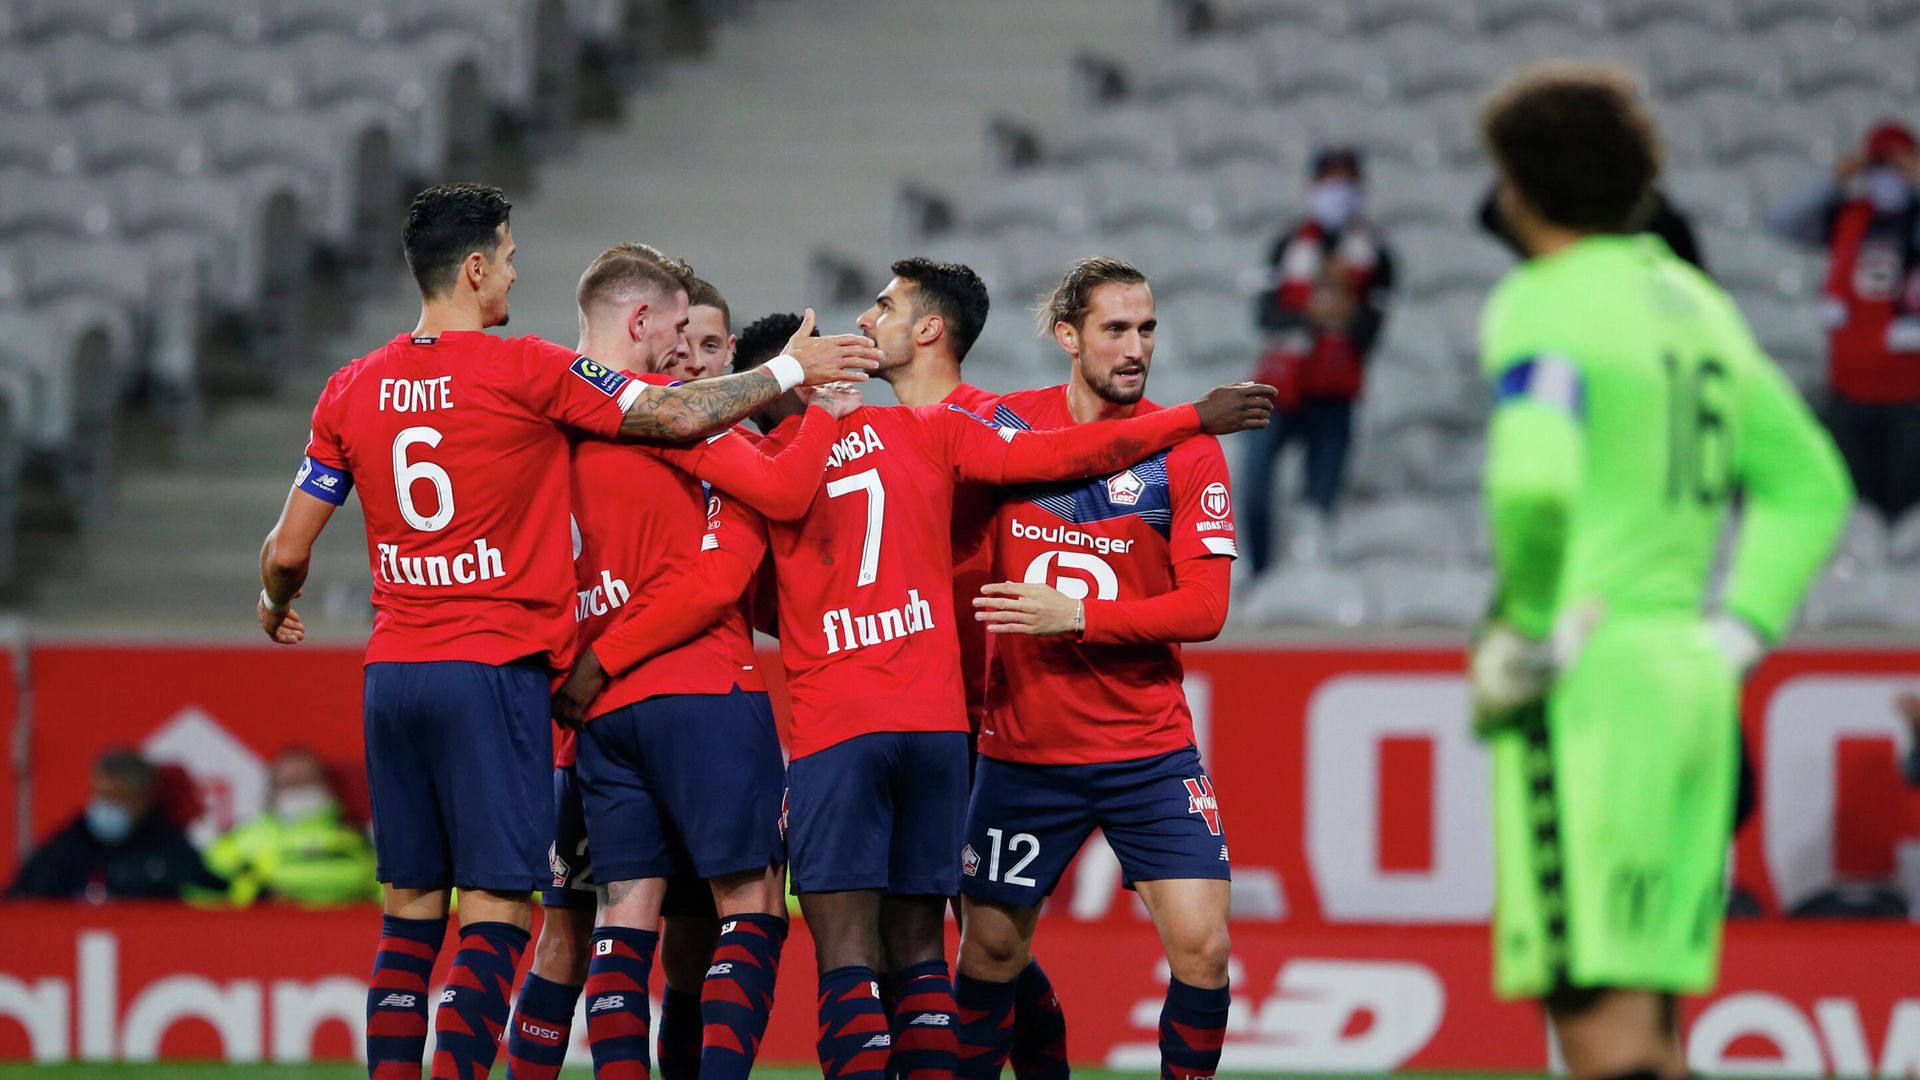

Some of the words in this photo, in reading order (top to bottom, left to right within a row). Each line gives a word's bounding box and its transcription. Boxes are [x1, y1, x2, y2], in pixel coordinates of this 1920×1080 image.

[379, 375, 454, 412] FONTE
[824, 424, 885, 471] AMBA
[392, 426, 455, 532] 6
[826, 467, 885, 587] 7
[1011, 518, 1134, 555] boulanger
[377, 538, 506, 586] flunch
[575, 569, 631, 623] nch
[822, 589, 936, 655] flunch
[986, 827, 1041, 888] 12
[522, 1021, 560, 1040] LOSC
